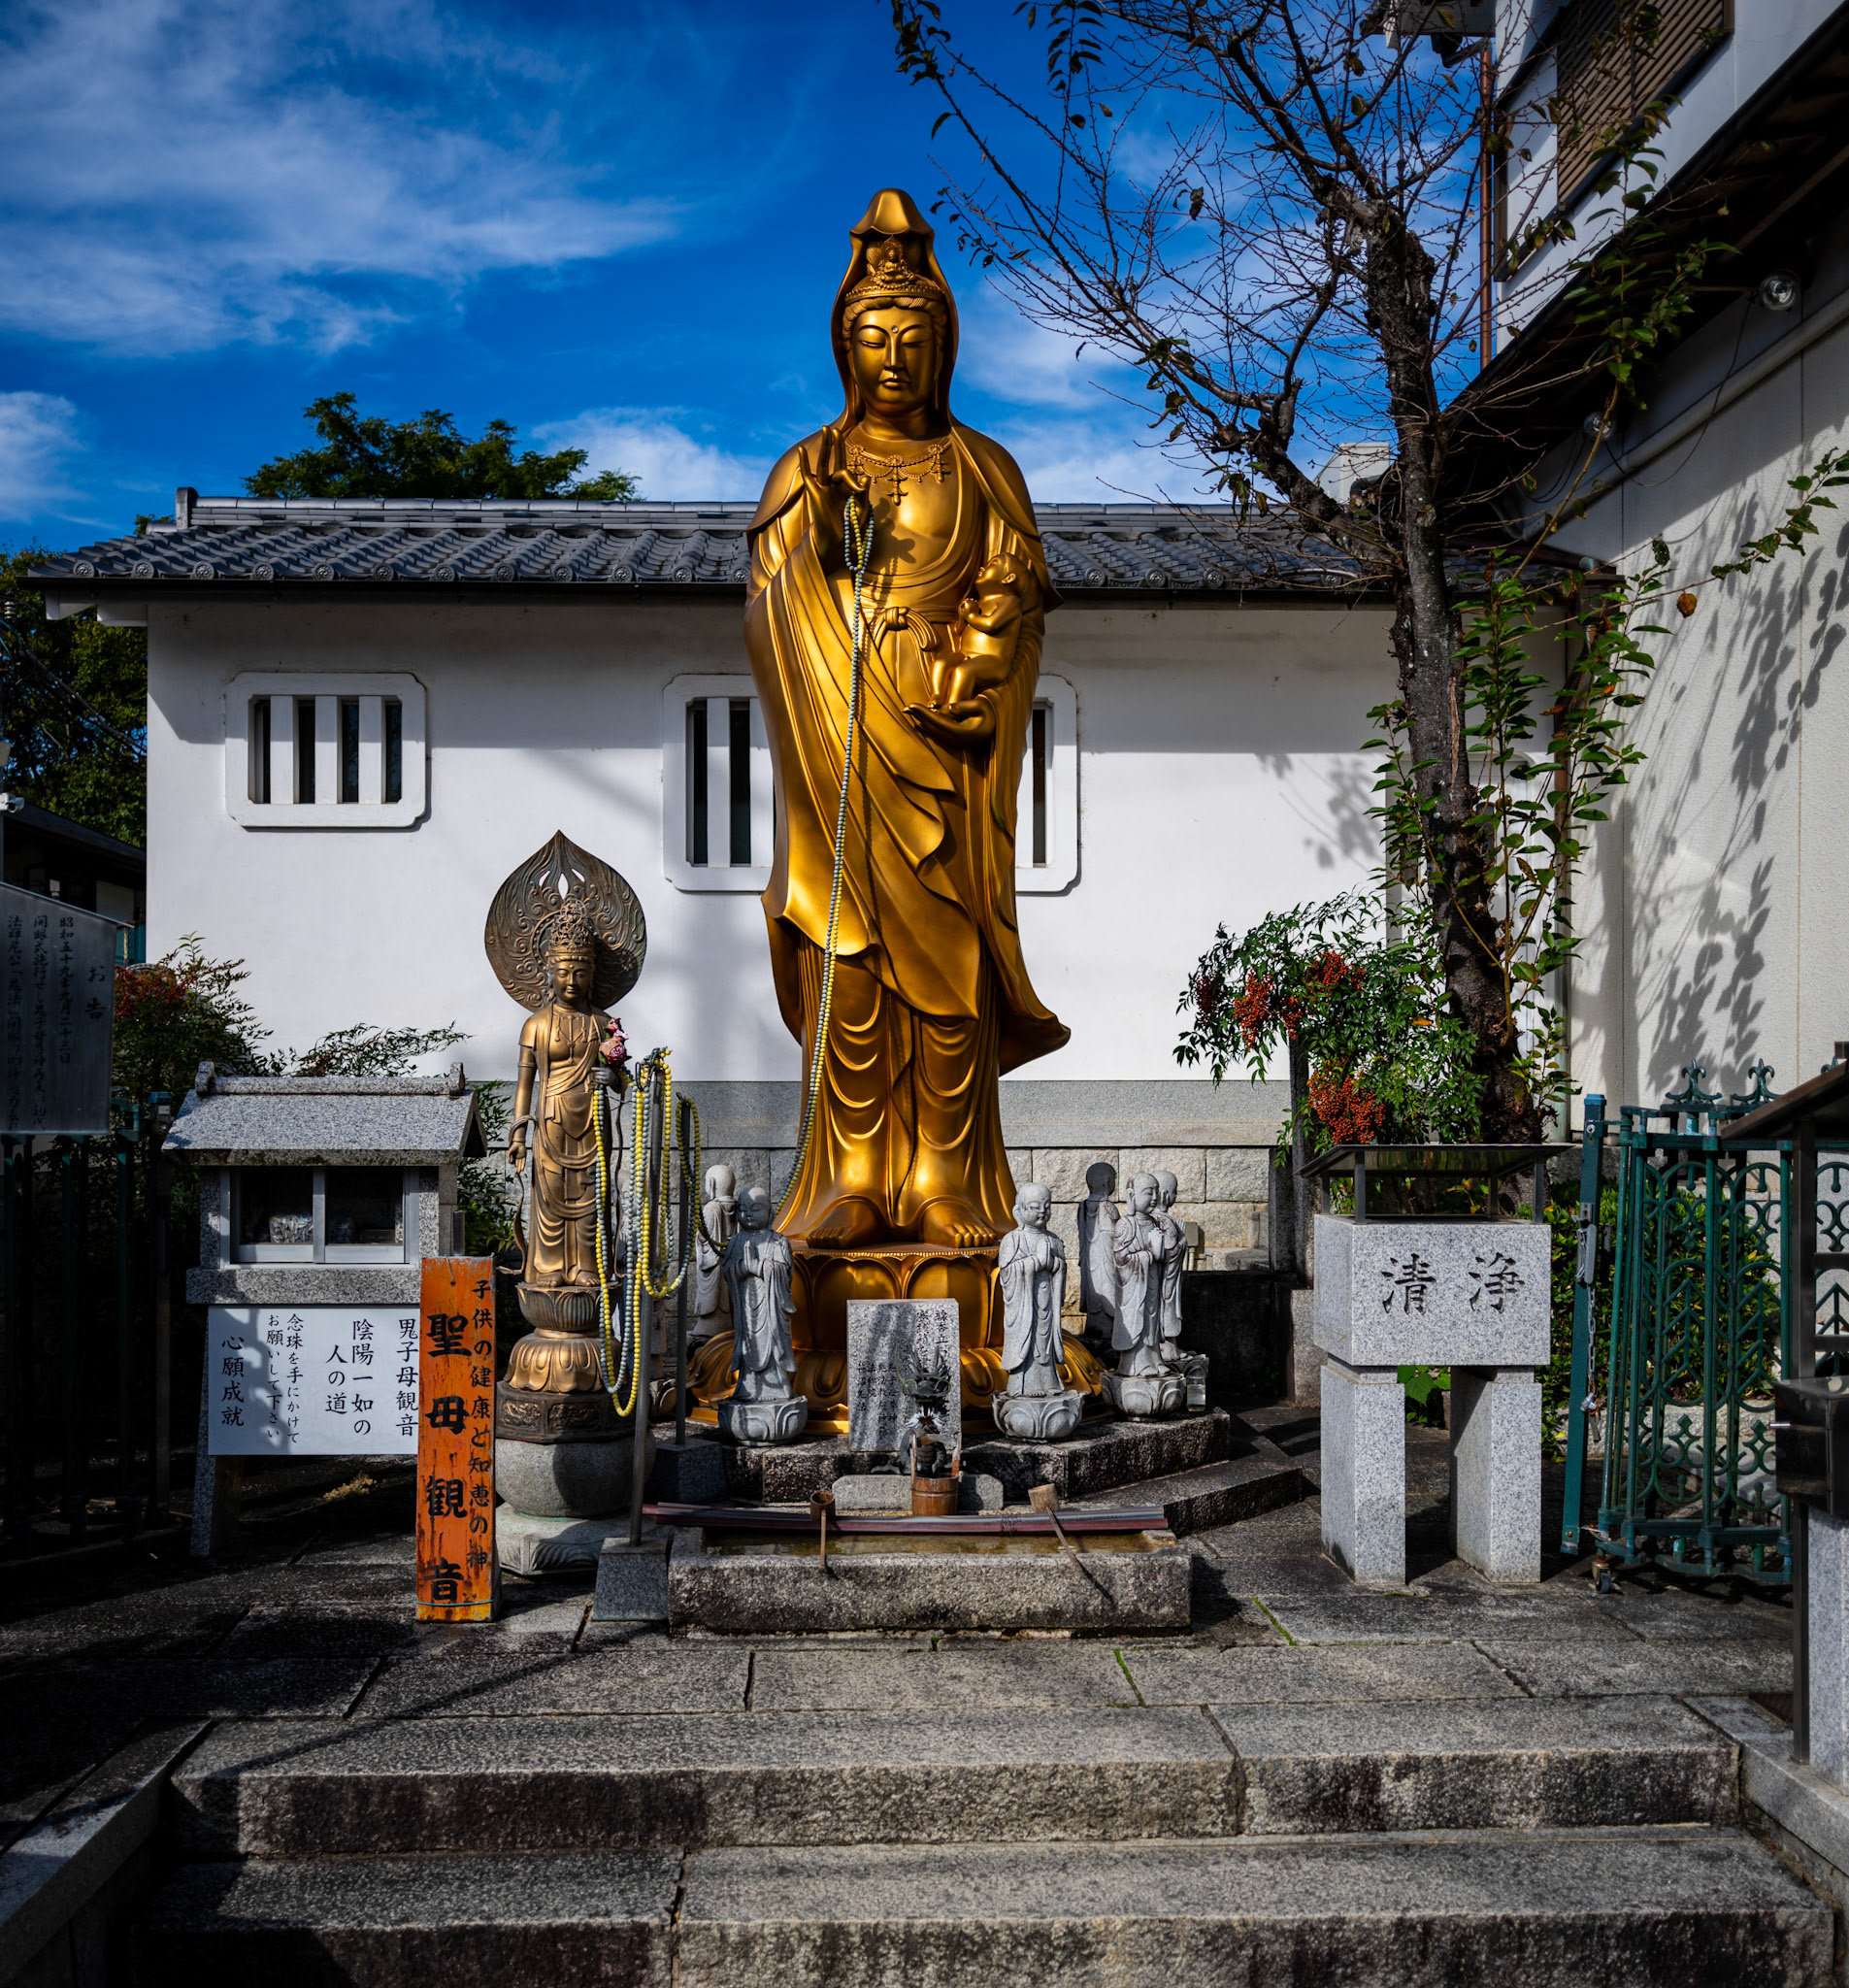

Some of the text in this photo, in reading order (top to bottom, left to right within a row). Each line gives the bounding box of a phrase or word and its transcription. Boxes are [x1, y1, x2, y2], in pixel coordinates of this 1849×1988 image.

[84, 965, 107, 1020] お告
[220, 1336, 245, 1427] 心願成就
[266, 1314, 283, 1439] お願いして下さい
[286, 1313, 304, 1443] 念珠を手にかけて
[325, 1344, 348, 1414] 人の道
[350, 1318, 375, 1436] 陰陽一如の
[396, 1318, 418, 1437] 鬼子母観音
[466, 1280, 492, 1571] 子供の健康と知恵の神
[424, 1312, 473, 1602] 聖母観音
